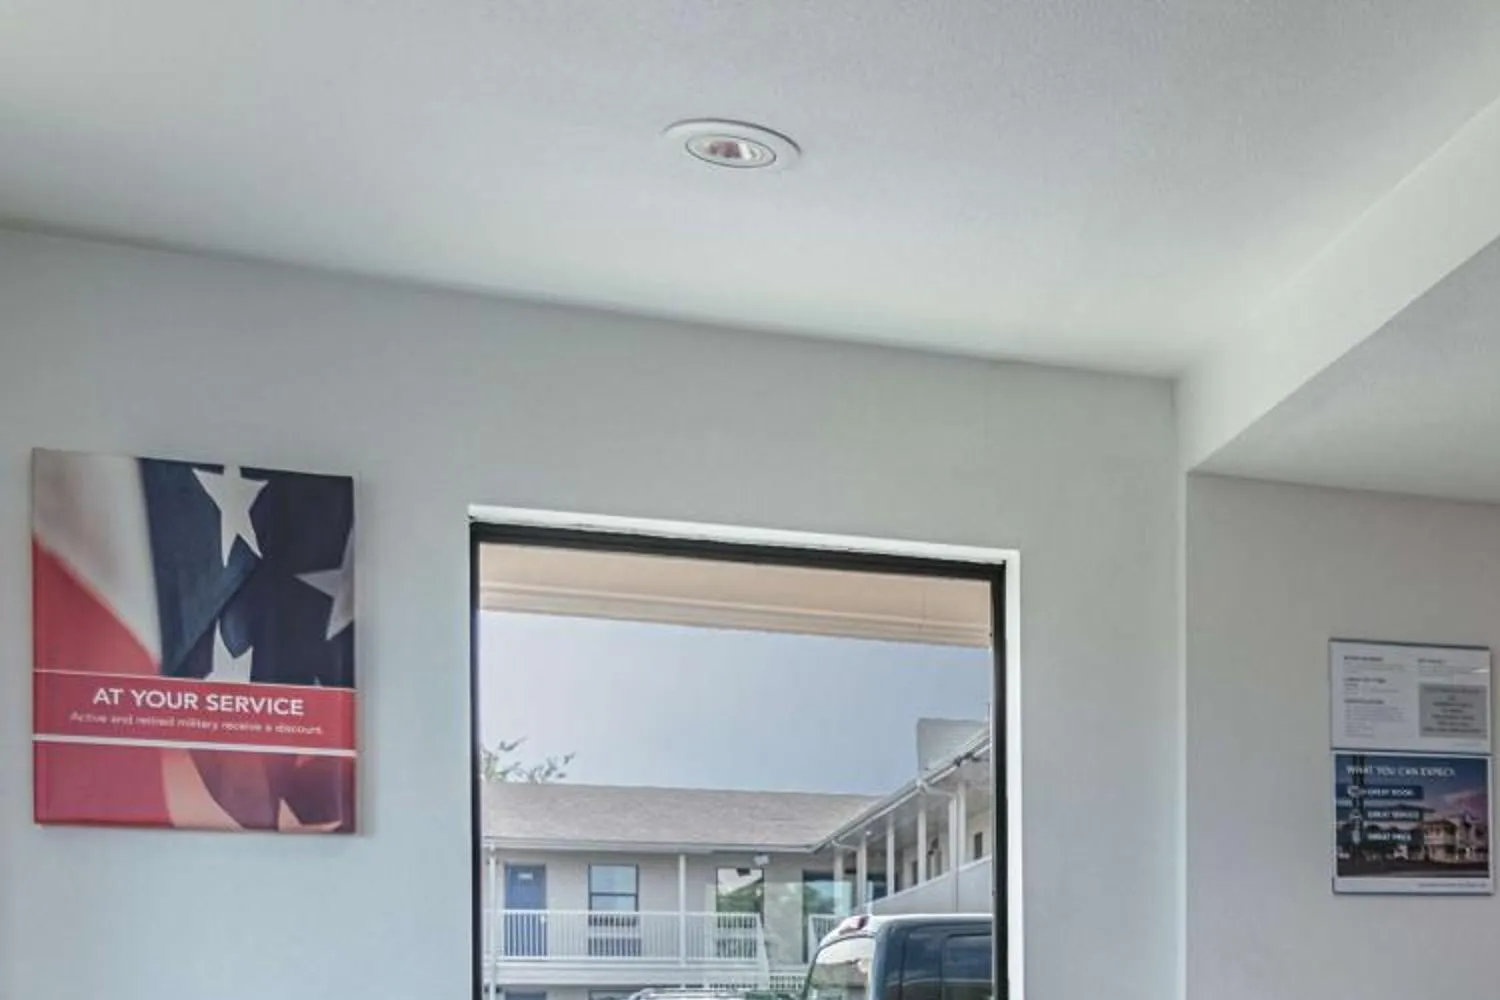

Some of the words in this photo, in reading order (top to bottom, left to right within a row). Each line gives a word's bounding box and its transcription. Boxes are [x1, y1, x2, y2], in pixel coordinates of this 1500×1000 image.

[92, 687, 124, 705] AT
[130, 689, 199, 710] YOUR
[206, 694, 305, 716] SERVICE
[111, 714, 133, 725] and
[221, 721, 262, 732] receive
